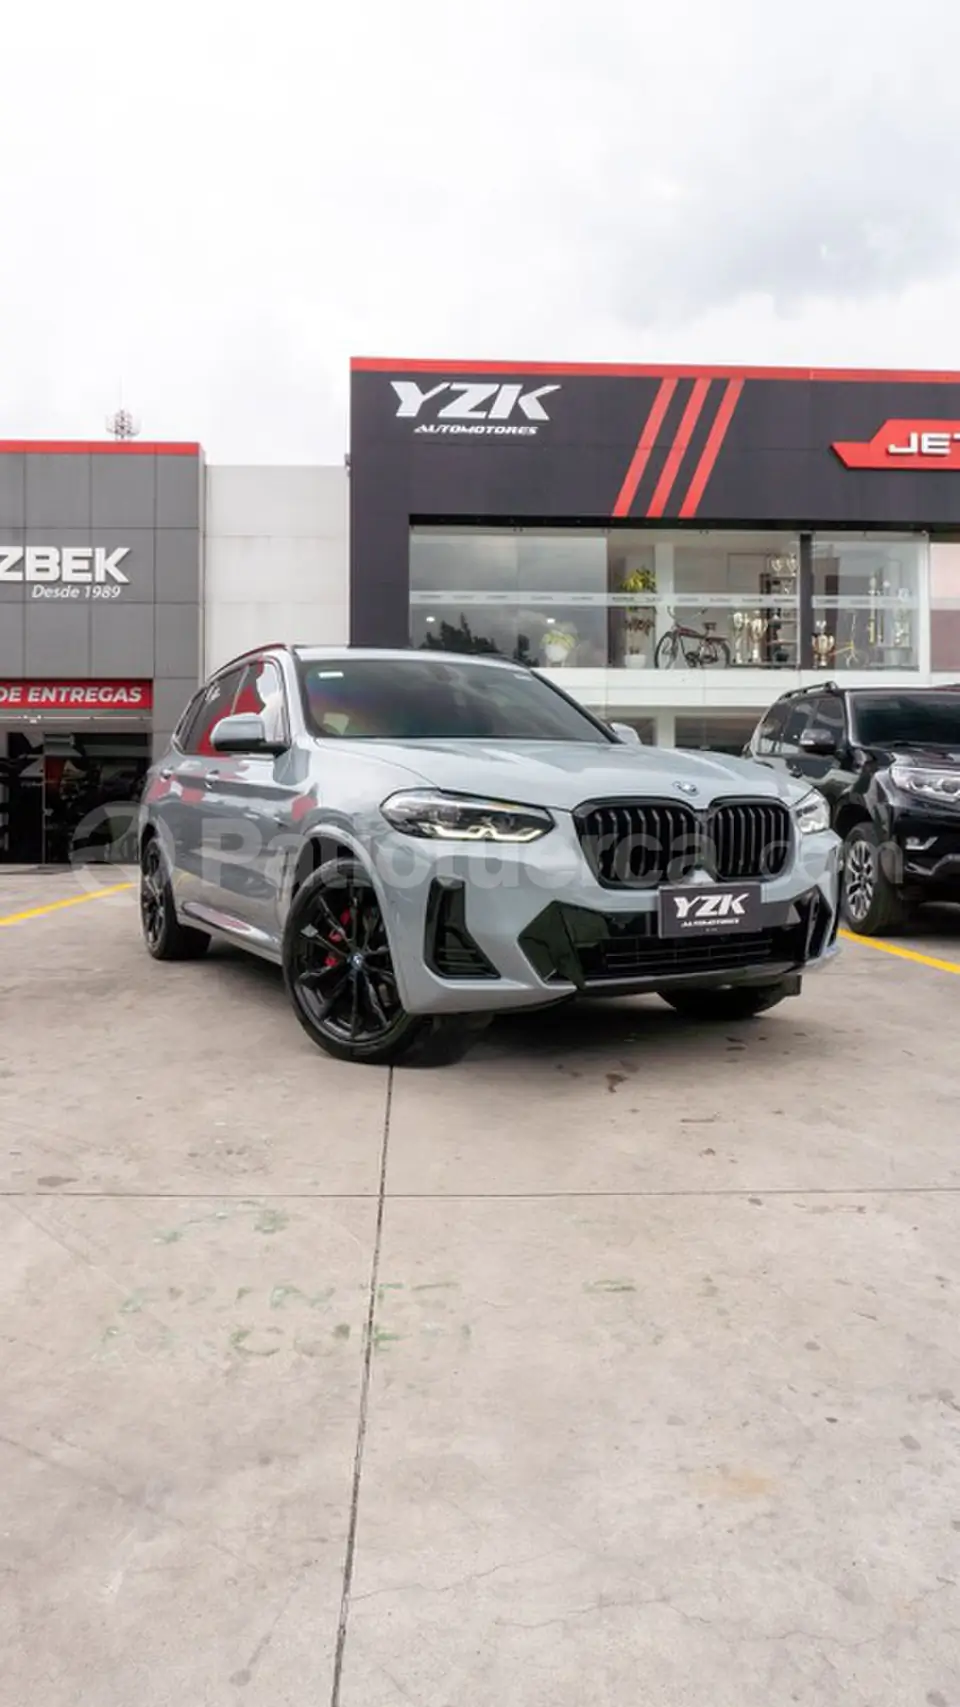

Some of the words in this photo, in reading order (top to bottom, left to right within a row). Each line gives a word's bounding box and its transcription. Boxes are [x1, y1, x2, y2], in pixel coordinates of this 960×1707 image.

[390, 381, 562, 421] YZK
[414, 424, 538, 435] AUTOMOTORES
[888, 432, 960, 454] JE
[32, 584, 80, 598] Desde
[85, 585, 121, 599] 1989
[28, 686, 142, 703] ENTREGAS
[673, 893, 750, 918] YZK
